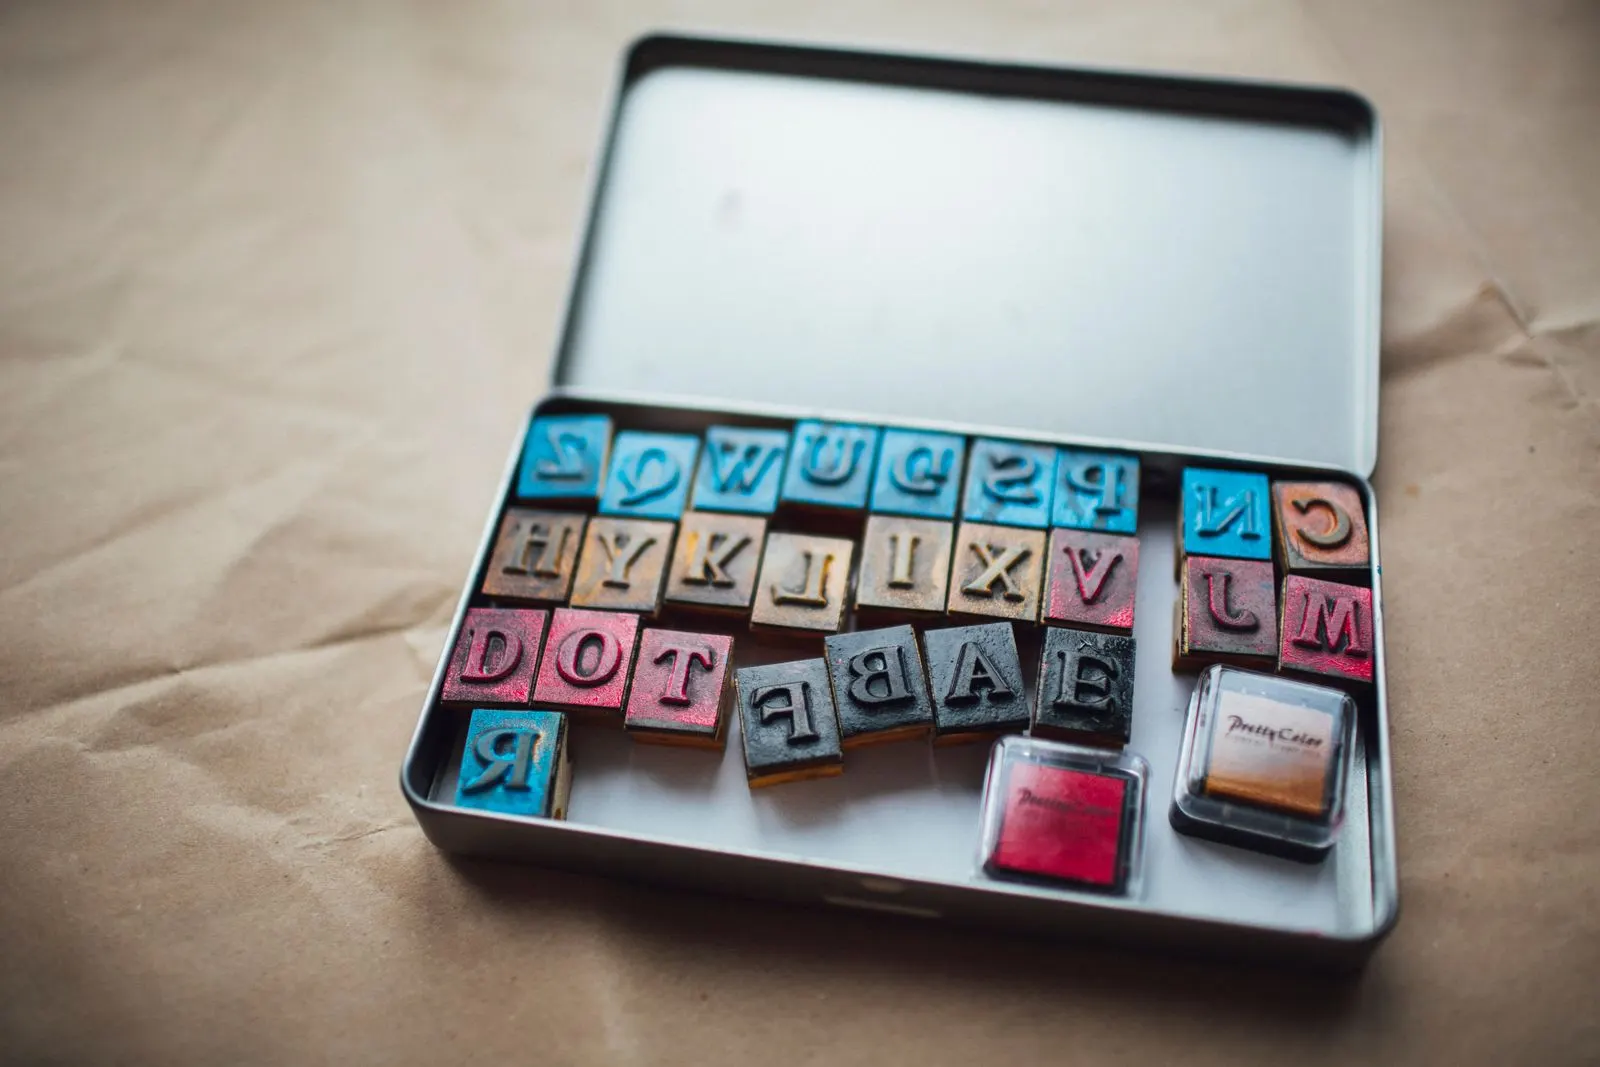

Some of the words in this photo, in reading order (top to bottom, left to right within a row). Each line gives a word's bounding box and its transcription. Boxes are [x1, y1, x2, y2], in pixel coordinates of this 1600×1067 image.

[707, 440, 787, 494] W
[803, 430, 867, 486] U
[502, 523, 574, 579] H
[599, 531, 658, 589] Y
[681, 530, 753, 588] K
[888, 533, 920, 589] I
[961, 541, 1032, 600] X
[1064, 545, 1123, 605] V
[1293, 591, 1368, 658] M
[460, 625, 523, 683] D
[556, 627, 623, 687] O
[653, 640, 714, 706] T
[943, 640, 1016, 701] A
[1052, 649, 1121, 711] E
